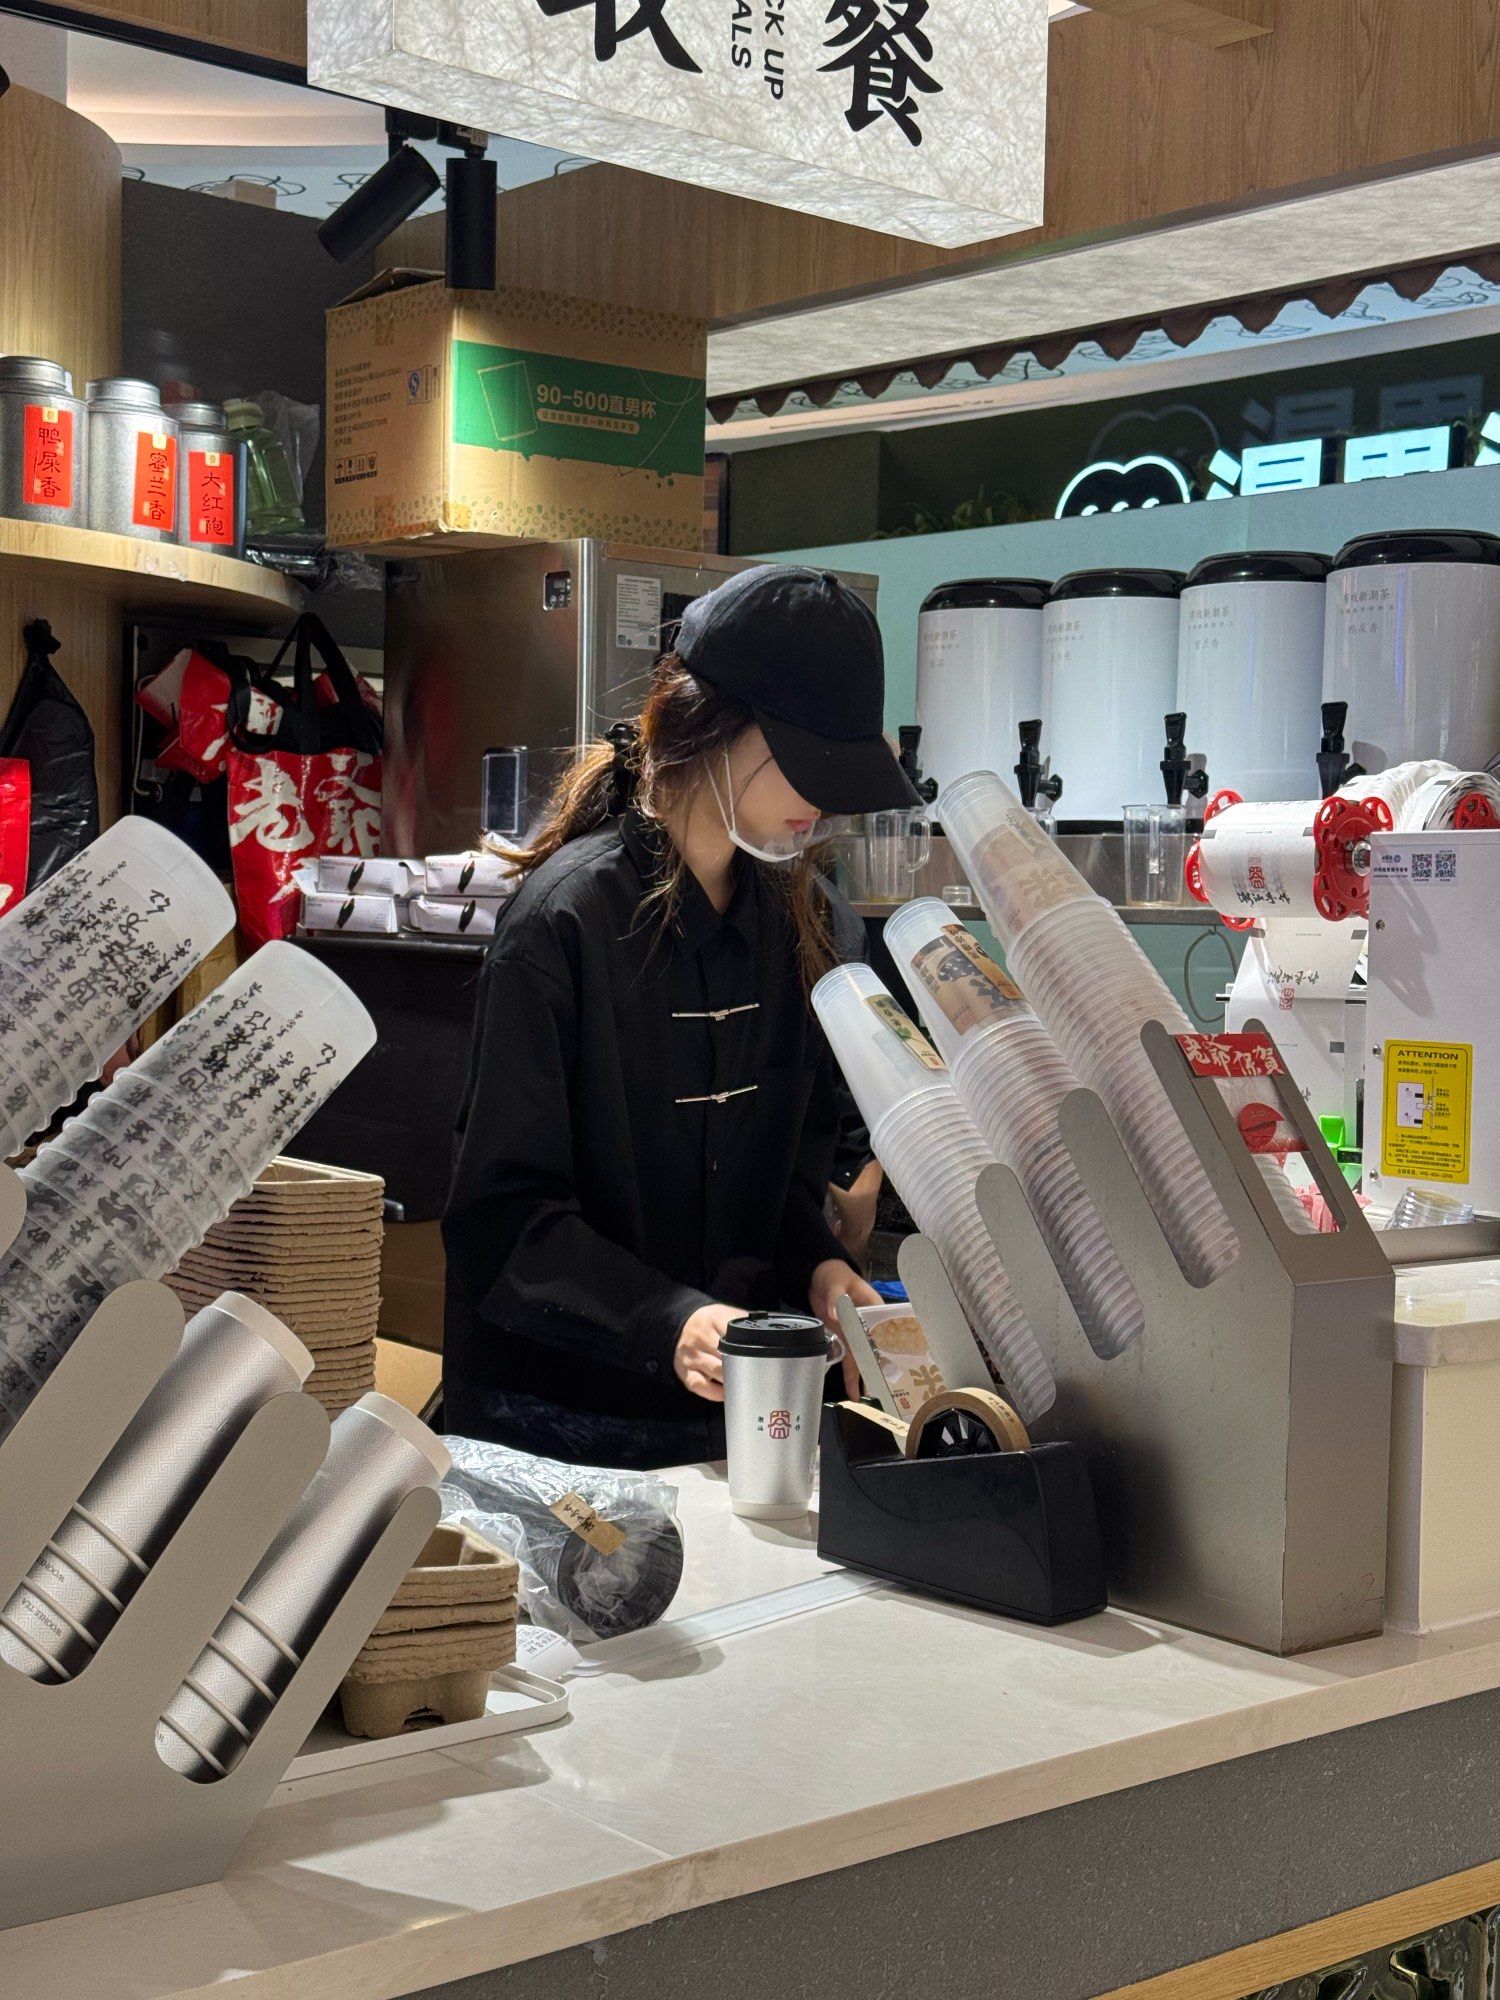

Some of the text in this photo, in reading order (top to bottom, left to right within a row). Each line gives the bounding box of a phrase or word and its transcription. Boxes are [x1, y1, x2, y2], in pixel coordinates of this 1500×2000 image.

[765, 49, 784, 100] UP
[537, 384, 657, 419] 90-500直男杯
[38, 427, 61, 498] 鸭屎香
[148, 452, 168, 521] 蜜兰香
[201, 472, 225, 536] 大红袍
[1397, 1050, 1459, 1061] ATTENTION
